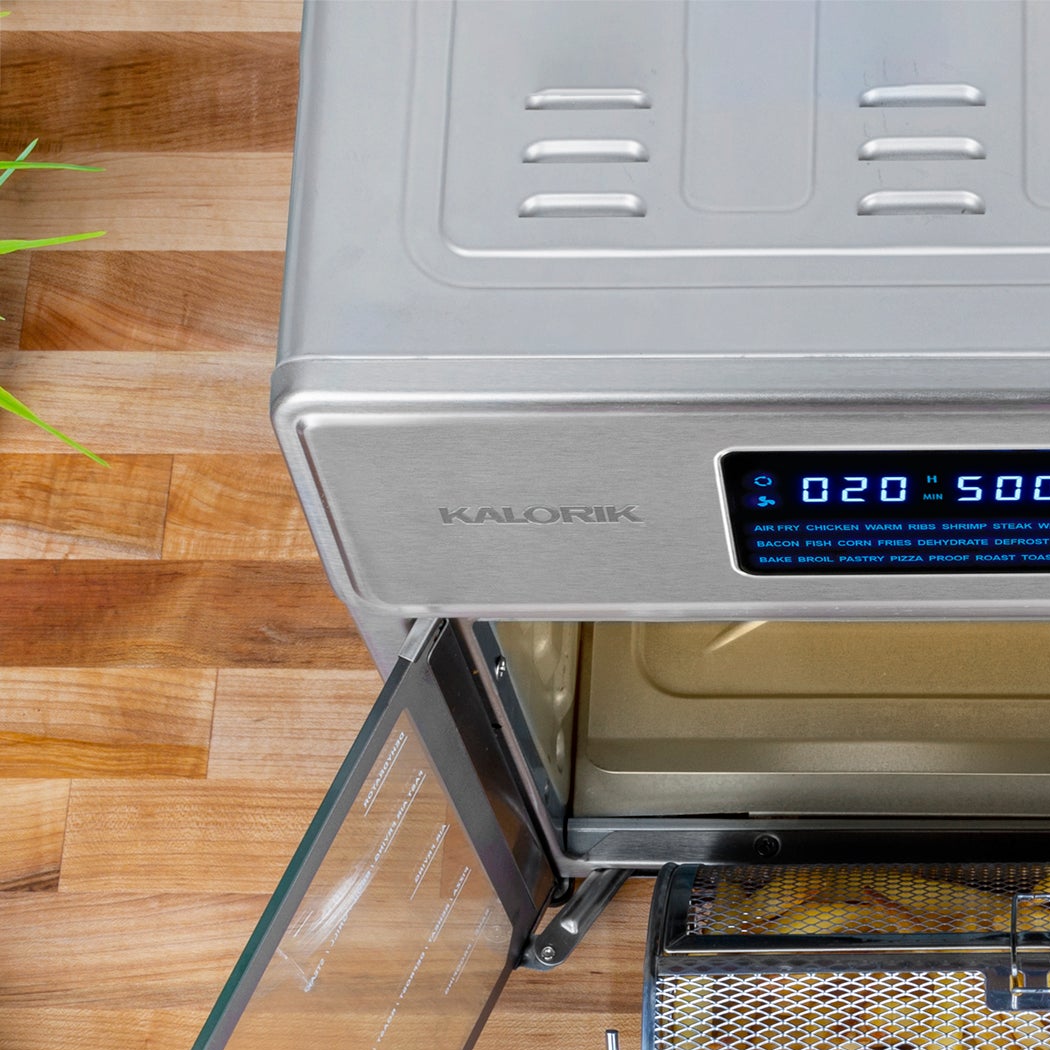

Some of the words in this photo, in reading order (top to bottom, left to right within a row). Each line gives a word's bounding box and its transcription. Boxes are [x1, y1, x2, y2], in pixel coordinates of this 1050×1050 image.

[926, 475, 938, 484] H
[801, 476, 908, 503] 020
[438, 506, 645, 525] KALORIK
[753, 524, 775, 532] AIR
[777, 524, 800, 532] FRY
[805, 523, 859, 532] CHICKEN
[864, 523, 903, 531] WARM
[908, 523, 936, 531] RIBS
[941, 522, 988, 531] SHRIMP
[992, 522, 1033, 530] STEAK
[756, 540, 800, 548] BACON
[805, 539, 832, 547] FISH
[837, 539, 872, 547] CORN
[877, 539, 912, 547] FRIES
[917, 538, 988, 546] DEHYDRATE
[994, 538, 1050, 546] DEFROST
[928, 554, 970, 562] PROOF
